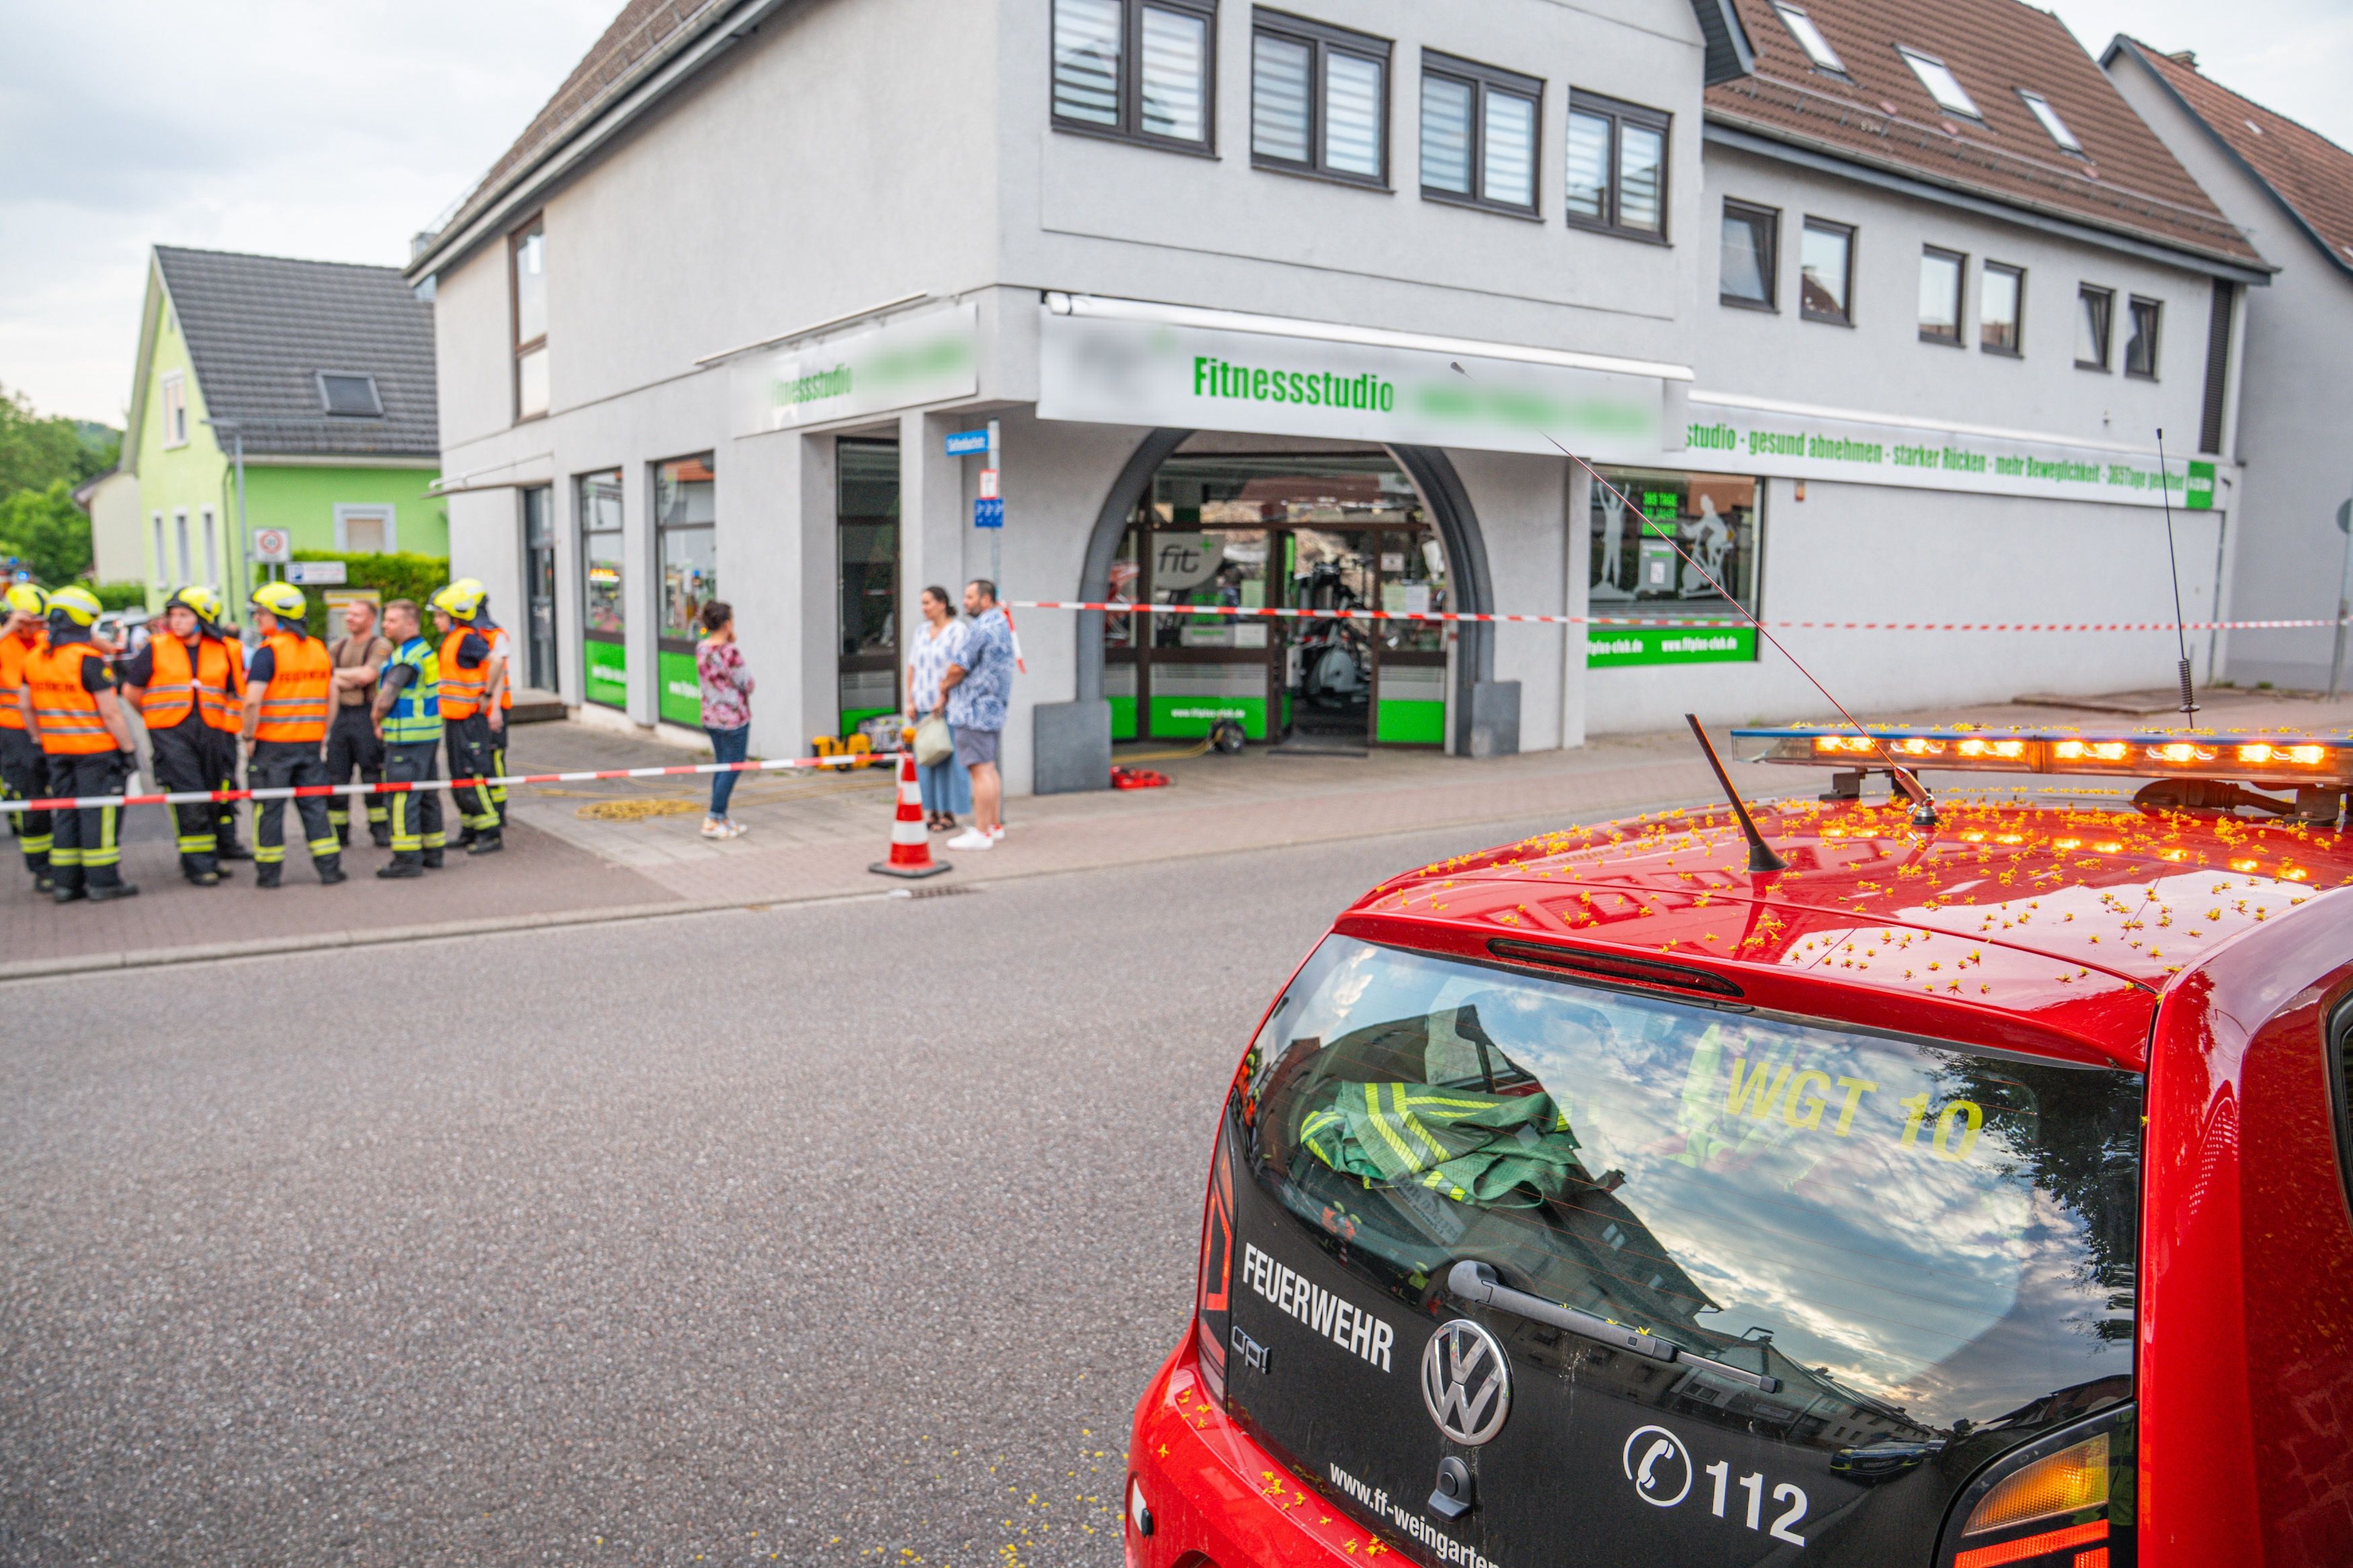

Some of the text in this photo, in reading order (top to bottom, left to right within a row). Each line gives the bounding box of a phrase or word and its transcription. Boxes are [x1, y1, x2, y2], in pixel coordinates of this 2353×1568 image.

[1194, 356, 1394, 412] Fitnessstudio
[1749, 431, 1806, 456] gesund
[1808, 434, 1882, 463] abnehmen
[1893, 444, 1940, 468] starker
[1942, 446, 1986, 473] Rücken
[1995, 454, 2024, 476] mehr
[2026, 456, 2100, 483] Beweglichkeit
[1727, 1058, 1984, 1163] WGT 10
[1243, 1242, 1394, 1373] FEUERWEHR
[1232, 1325, 1271, 1374] up!
[1706, 1460, 1808, 1547] 112
